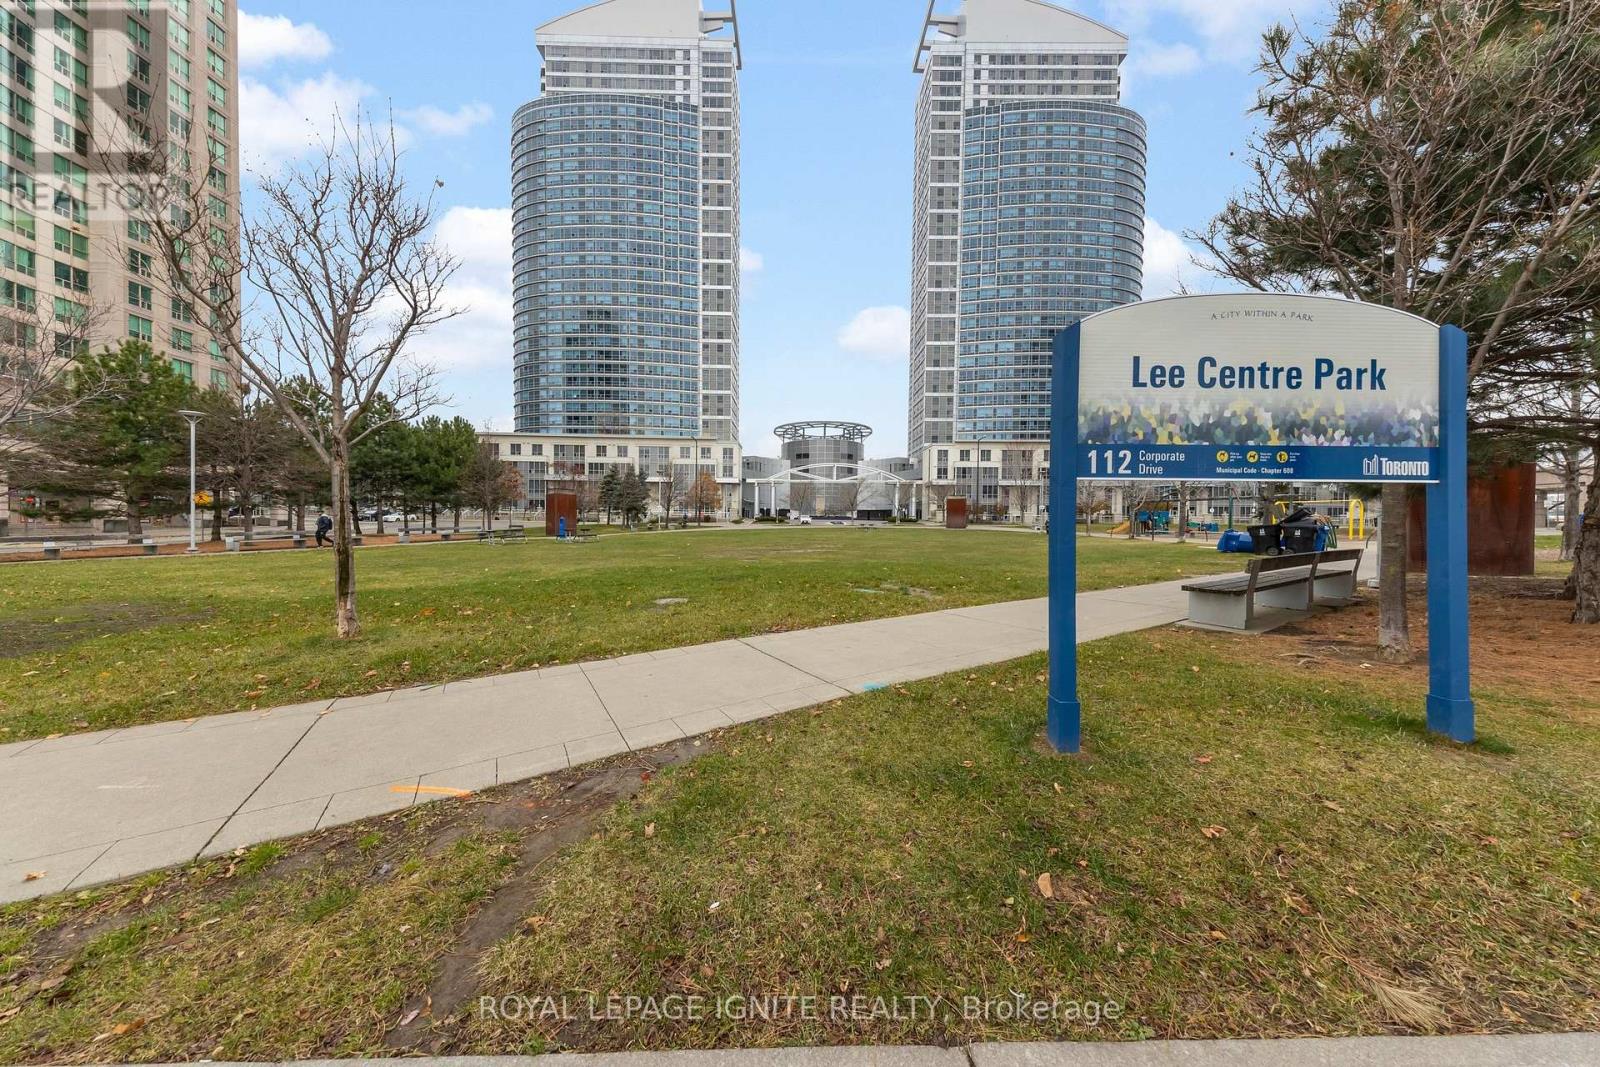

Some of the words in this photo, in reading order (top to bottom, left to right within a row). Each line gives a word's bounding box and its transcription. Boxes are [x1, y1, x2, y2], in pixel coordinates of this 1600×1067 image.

[1220, 311, 1240, 319] CITY
[1244, 309, 1277, 318] WITHIN
[1291, 311, 1314, 321] PARK
[1132, 355, 1186, 388] Lee
[1198, 356, 1303, 390] Centre
[1314, 358, 1387, 391] Park
[1088, 449, 1132, 474] 112
[1139, 450, 1185, 464] Corporate
[1139, 463, 1164, 474] Drive
[1261, 467, 1282, 475] Chapter
[1380, 457, 1429, 476] TORONTO
